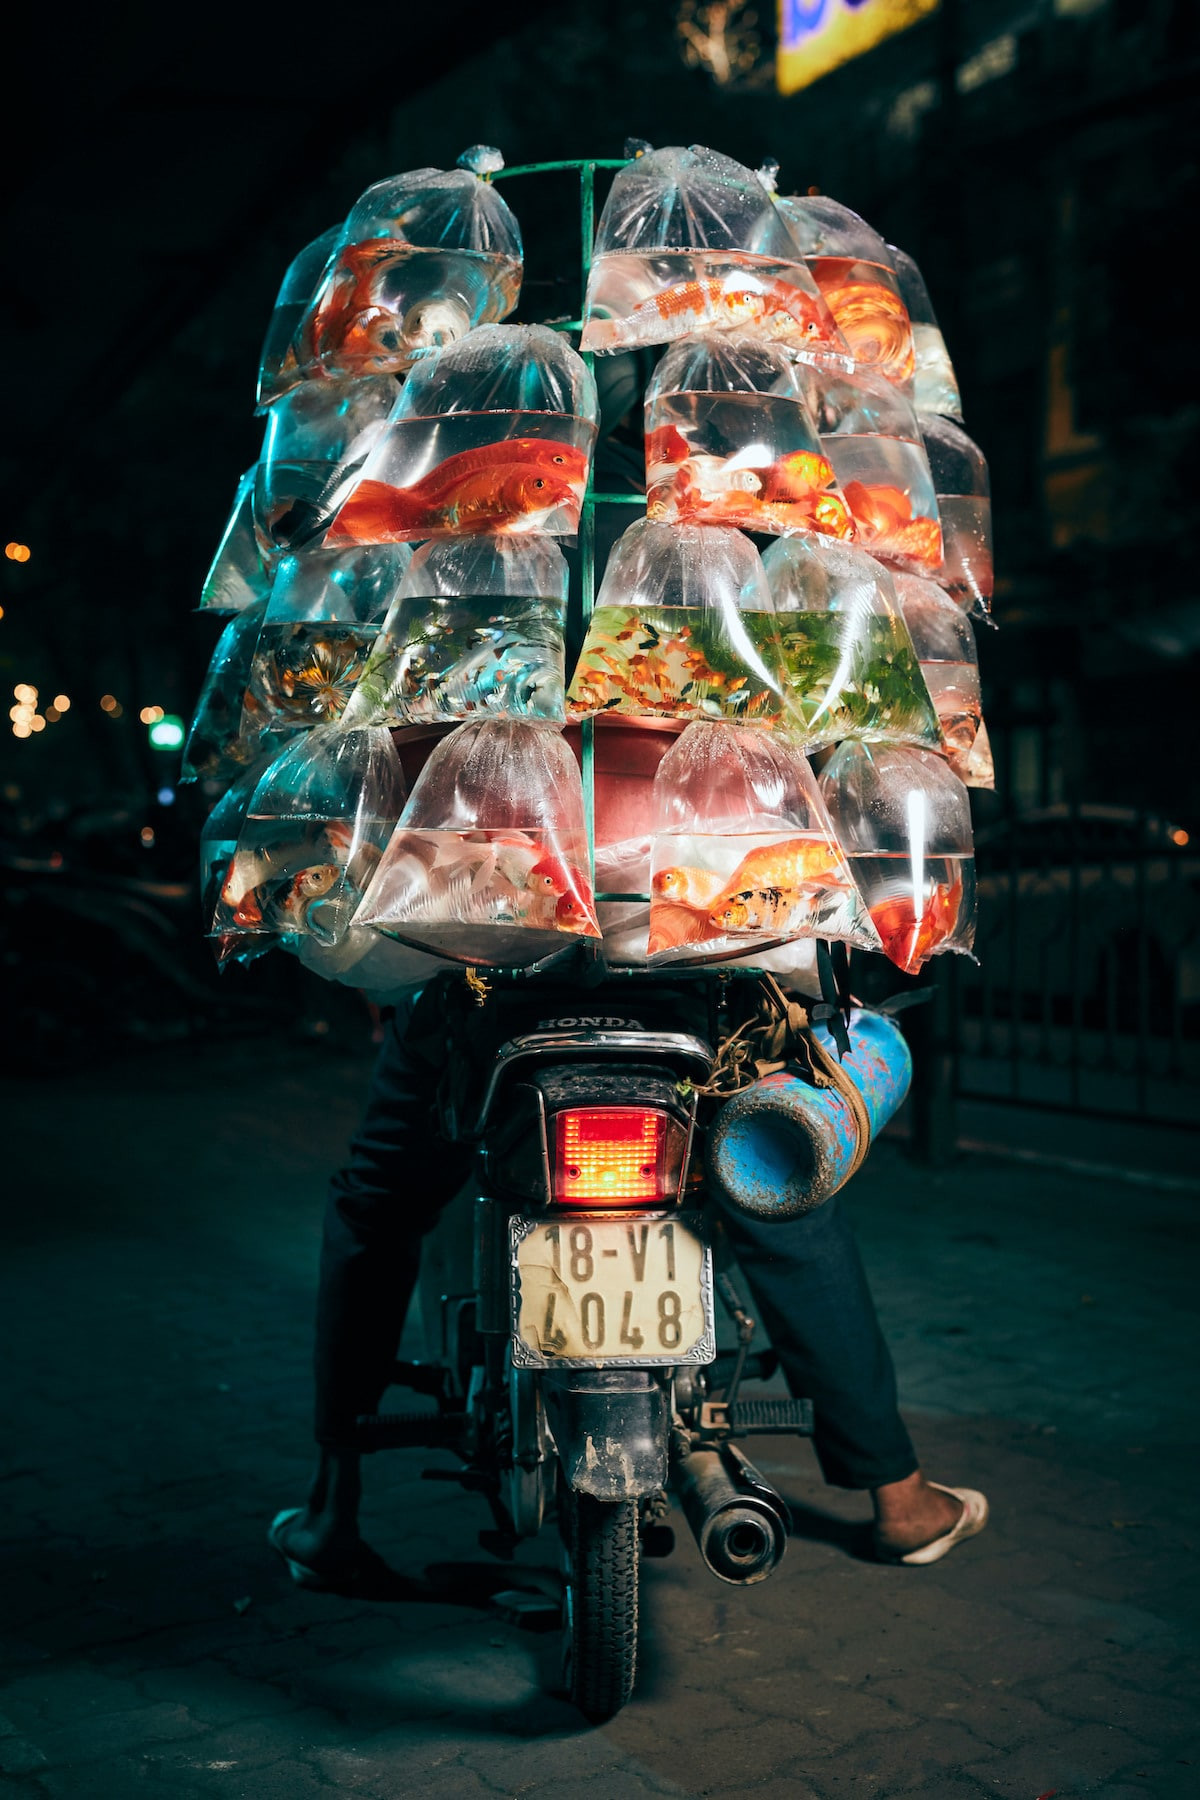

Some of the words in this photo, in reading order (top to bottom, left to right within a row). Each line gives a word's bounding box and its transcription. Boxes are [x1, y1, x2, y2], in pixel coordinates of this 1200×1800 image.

[536, 1017, 645, 1031] HONDA
[545, 1223, 675, 1284] 18-V1
[543, 1290, 683, 1350] 4048
